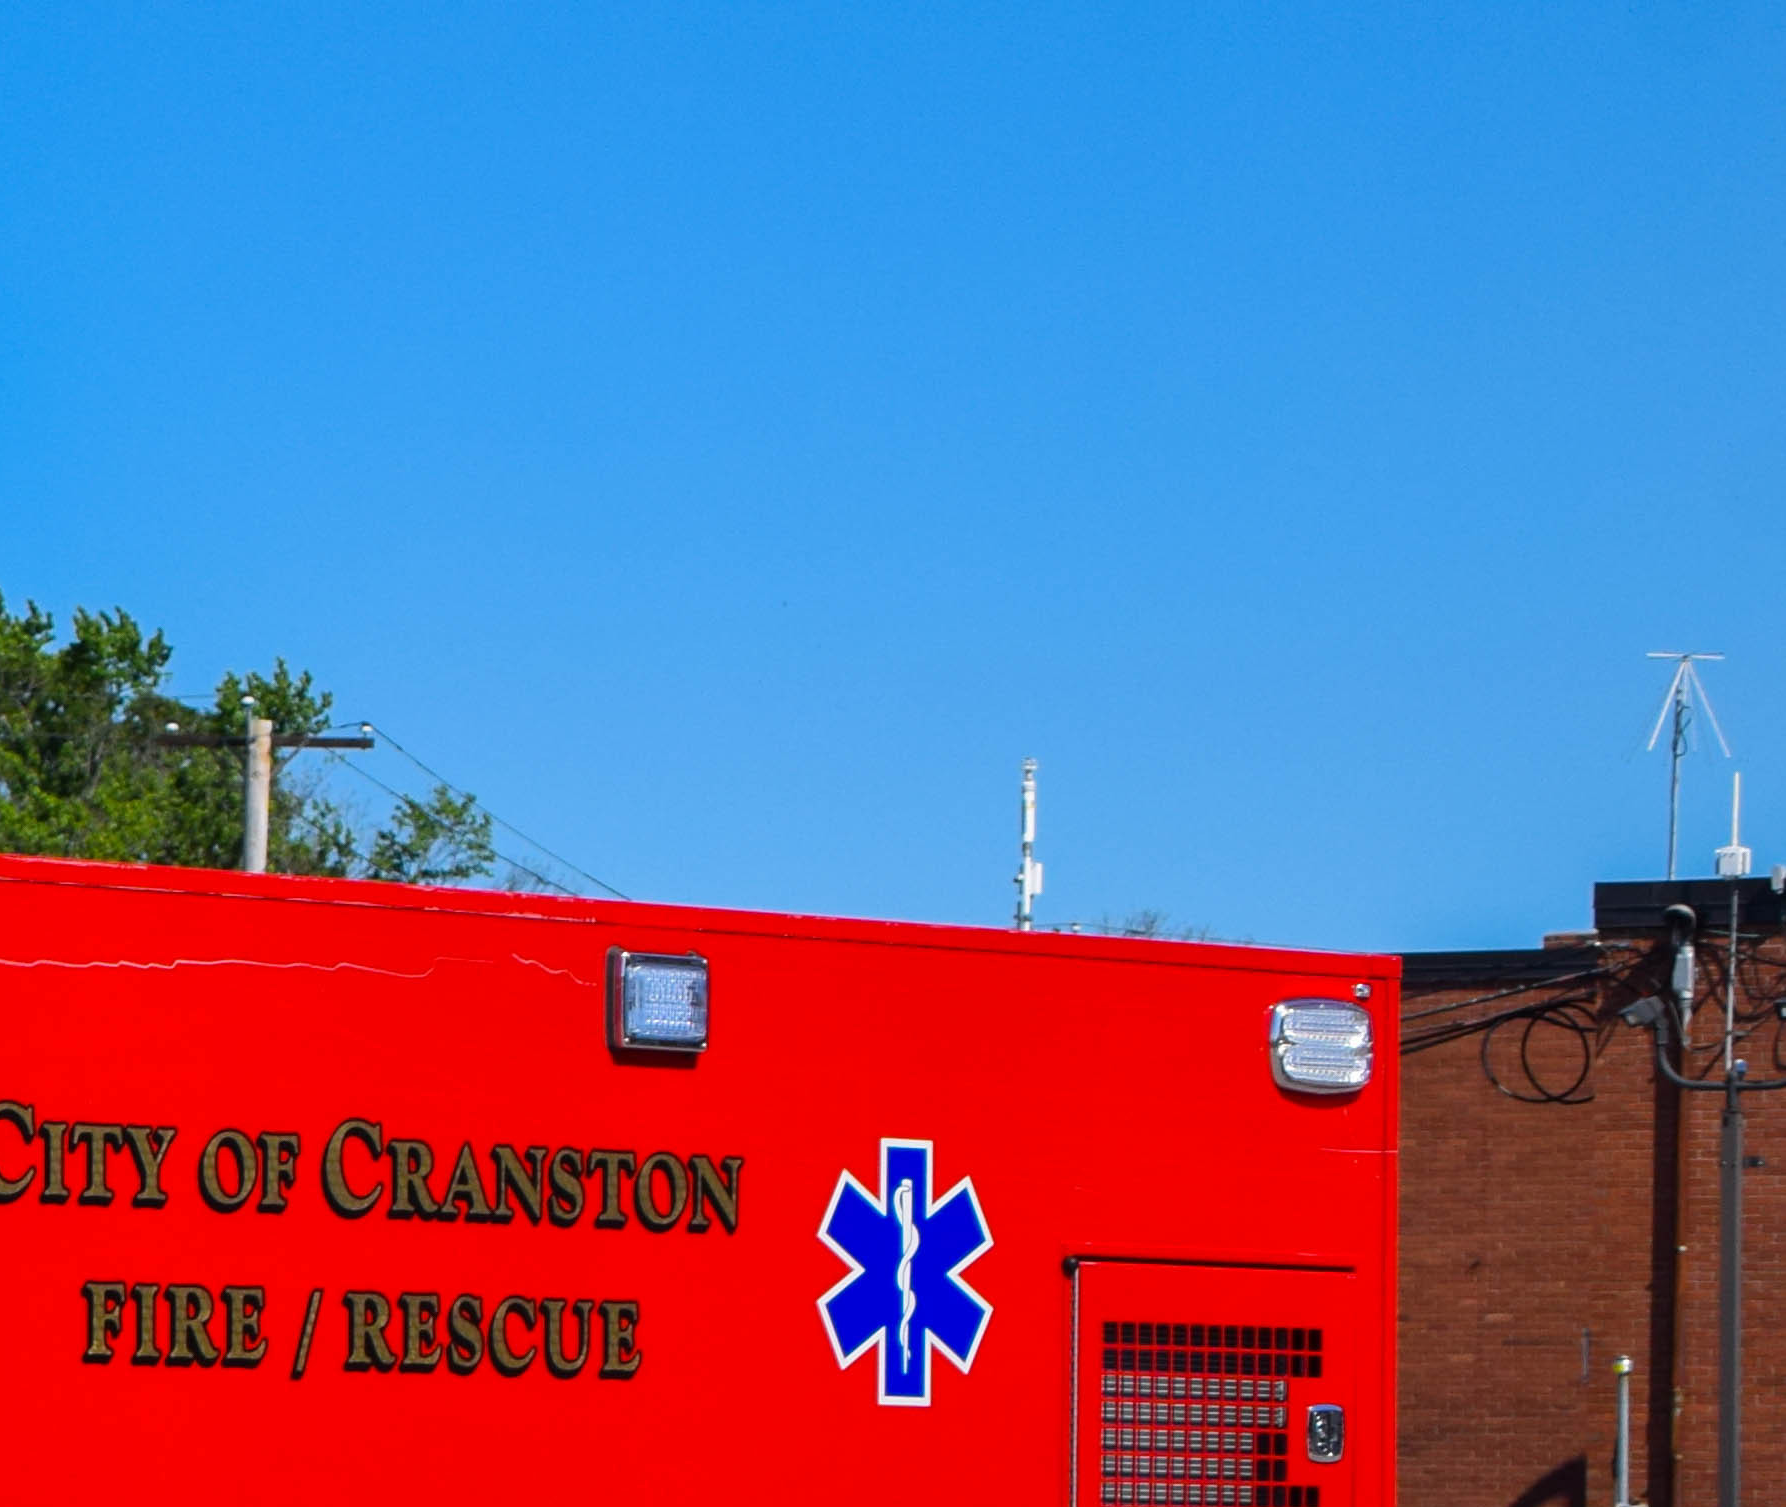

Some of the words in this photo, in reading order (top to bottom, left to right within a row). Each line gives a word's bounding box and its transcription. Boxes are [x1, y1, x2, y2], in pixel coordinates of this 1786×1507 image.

[198, 1130, 300, 1213] OF
[321, 1118, 743, 1234] CRANSTON
[81, 1280, 268, 1367] FIRE
[291, 1287, 324, 1380] /
[343, 1288, 643, 1381] RESCUE
